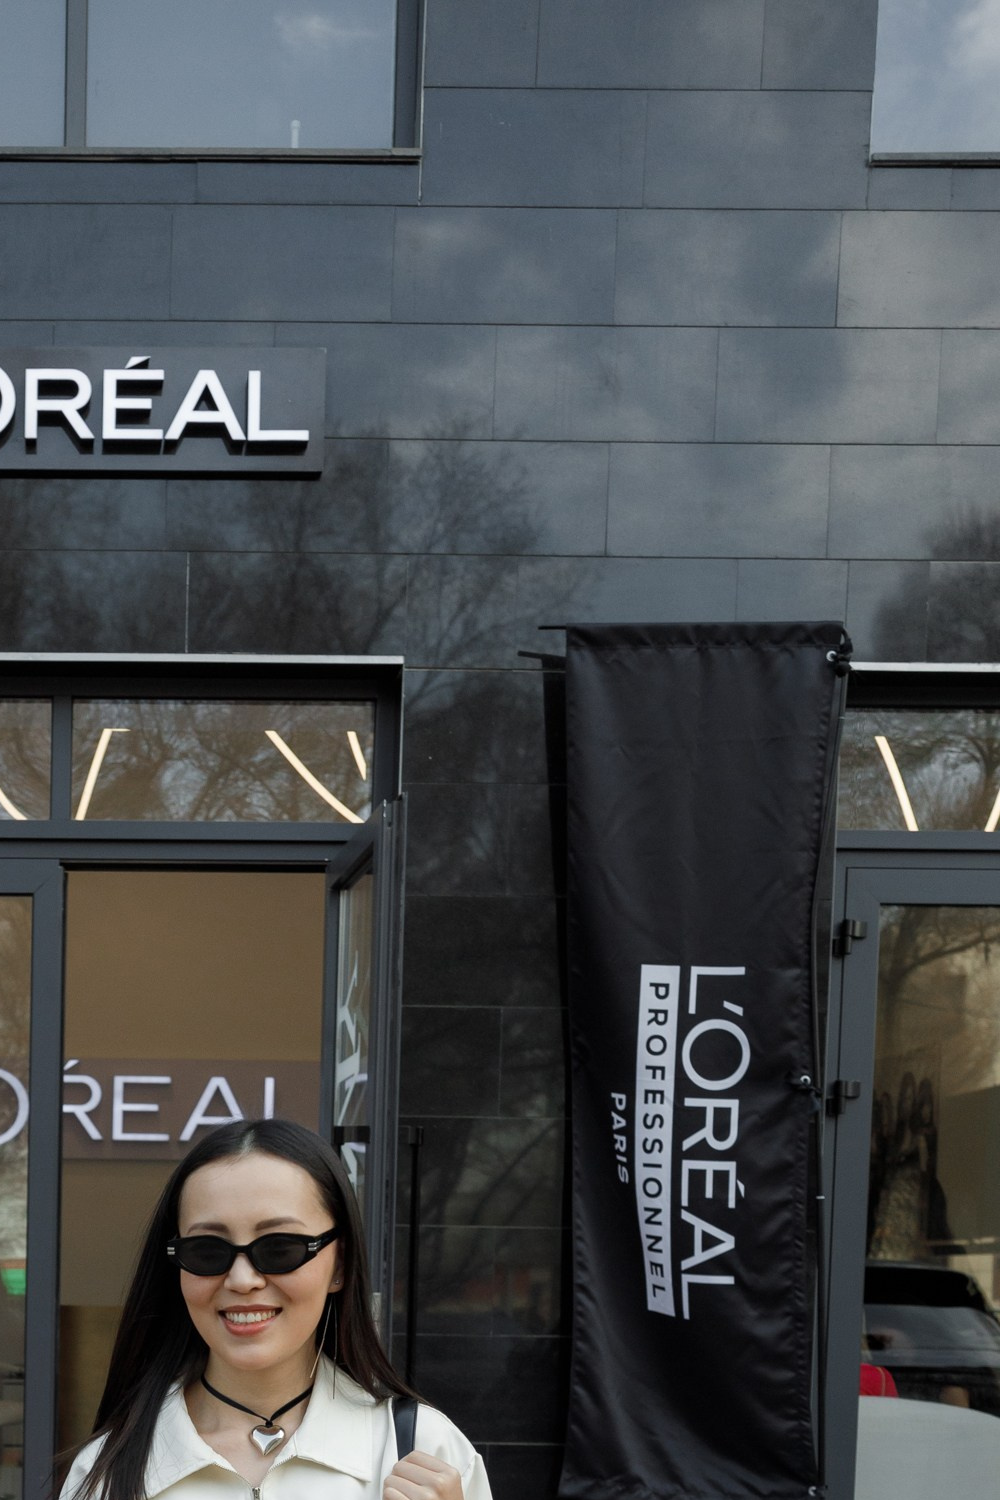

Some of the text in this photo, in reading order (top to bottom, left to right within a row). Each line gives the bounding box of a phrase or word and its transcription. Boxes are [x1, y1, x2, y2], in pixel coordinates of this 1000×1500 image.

[610, 1091, 630, 1185] PARIS
[642, 982, 670, 1299] PROFESSIONNEL
[681, 965, 751, 1320] L'ORÉAL
